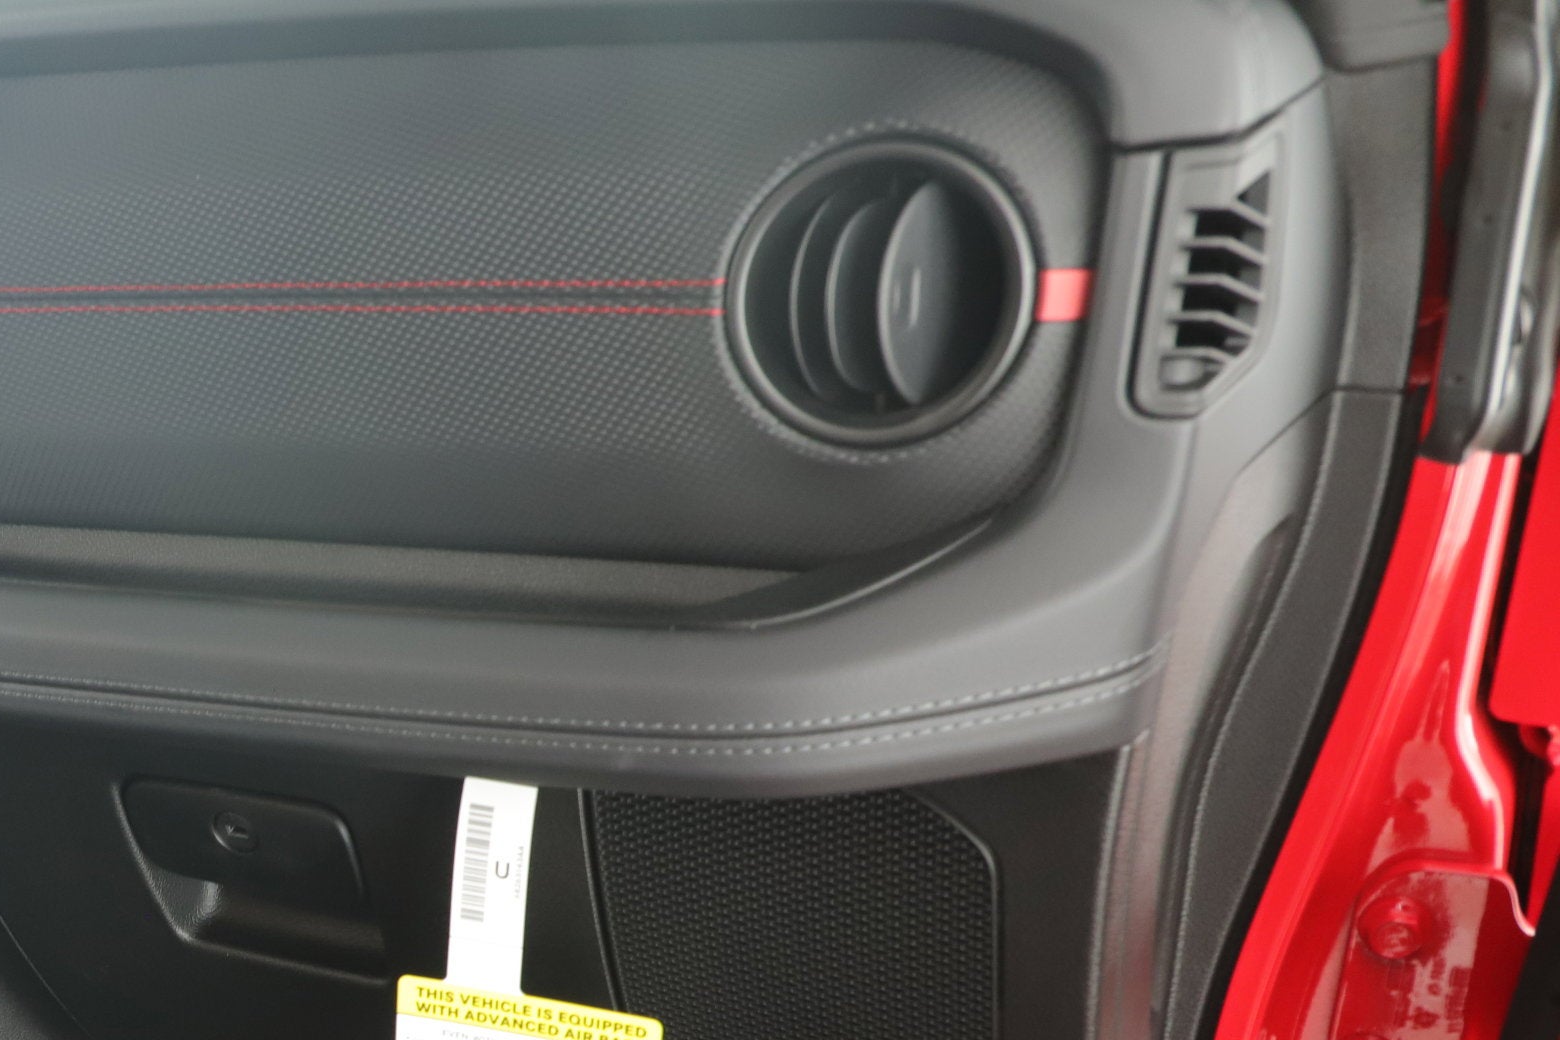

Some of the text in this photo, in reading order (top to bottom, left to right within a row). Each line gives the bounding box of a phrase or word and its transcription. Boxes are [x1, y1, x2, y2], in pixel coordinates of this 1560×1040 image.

[495, 860, 510, 880] U
[416, 1001, 458, 1018] WITH
[465, 1010, 559, 1036] ADVANCED
[417, 986, 647, 1039] THIS VEHICLE IS EQUIPPED
